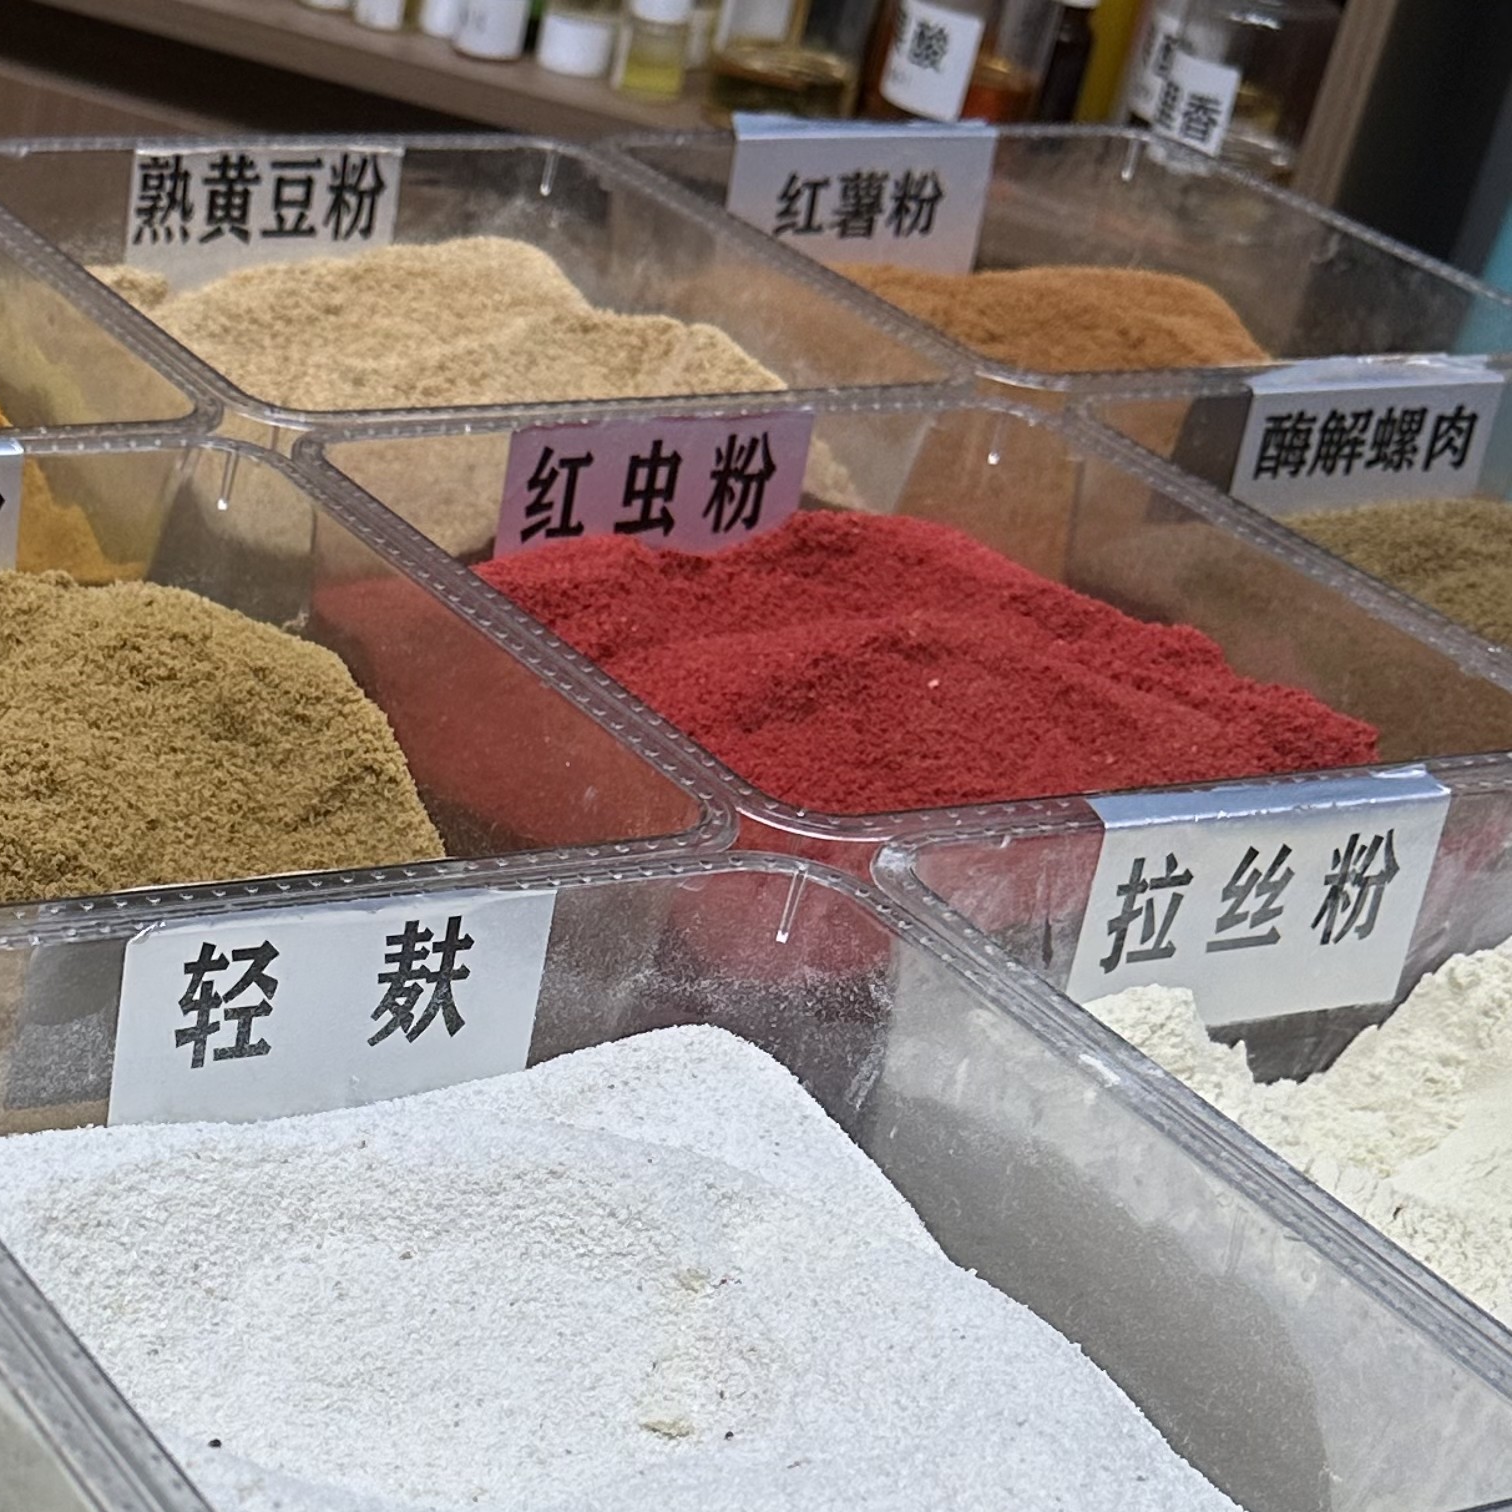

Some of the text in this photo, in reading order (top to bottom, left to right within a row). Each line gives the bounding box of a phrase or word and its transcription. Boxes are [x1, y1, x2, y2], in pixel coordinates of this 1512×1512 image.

[132, 152, 388, 247] 熟黄豆粉
[771, 168, 946, 242] 红薯粉
[519, 430, 778, 544] 红虫粉
[1252, 404, 1479, 481] 酶解螺肉
[1099, 827, 1400, 975] 拉丝粉
[174, 915, 475, 1070] 轻麸
